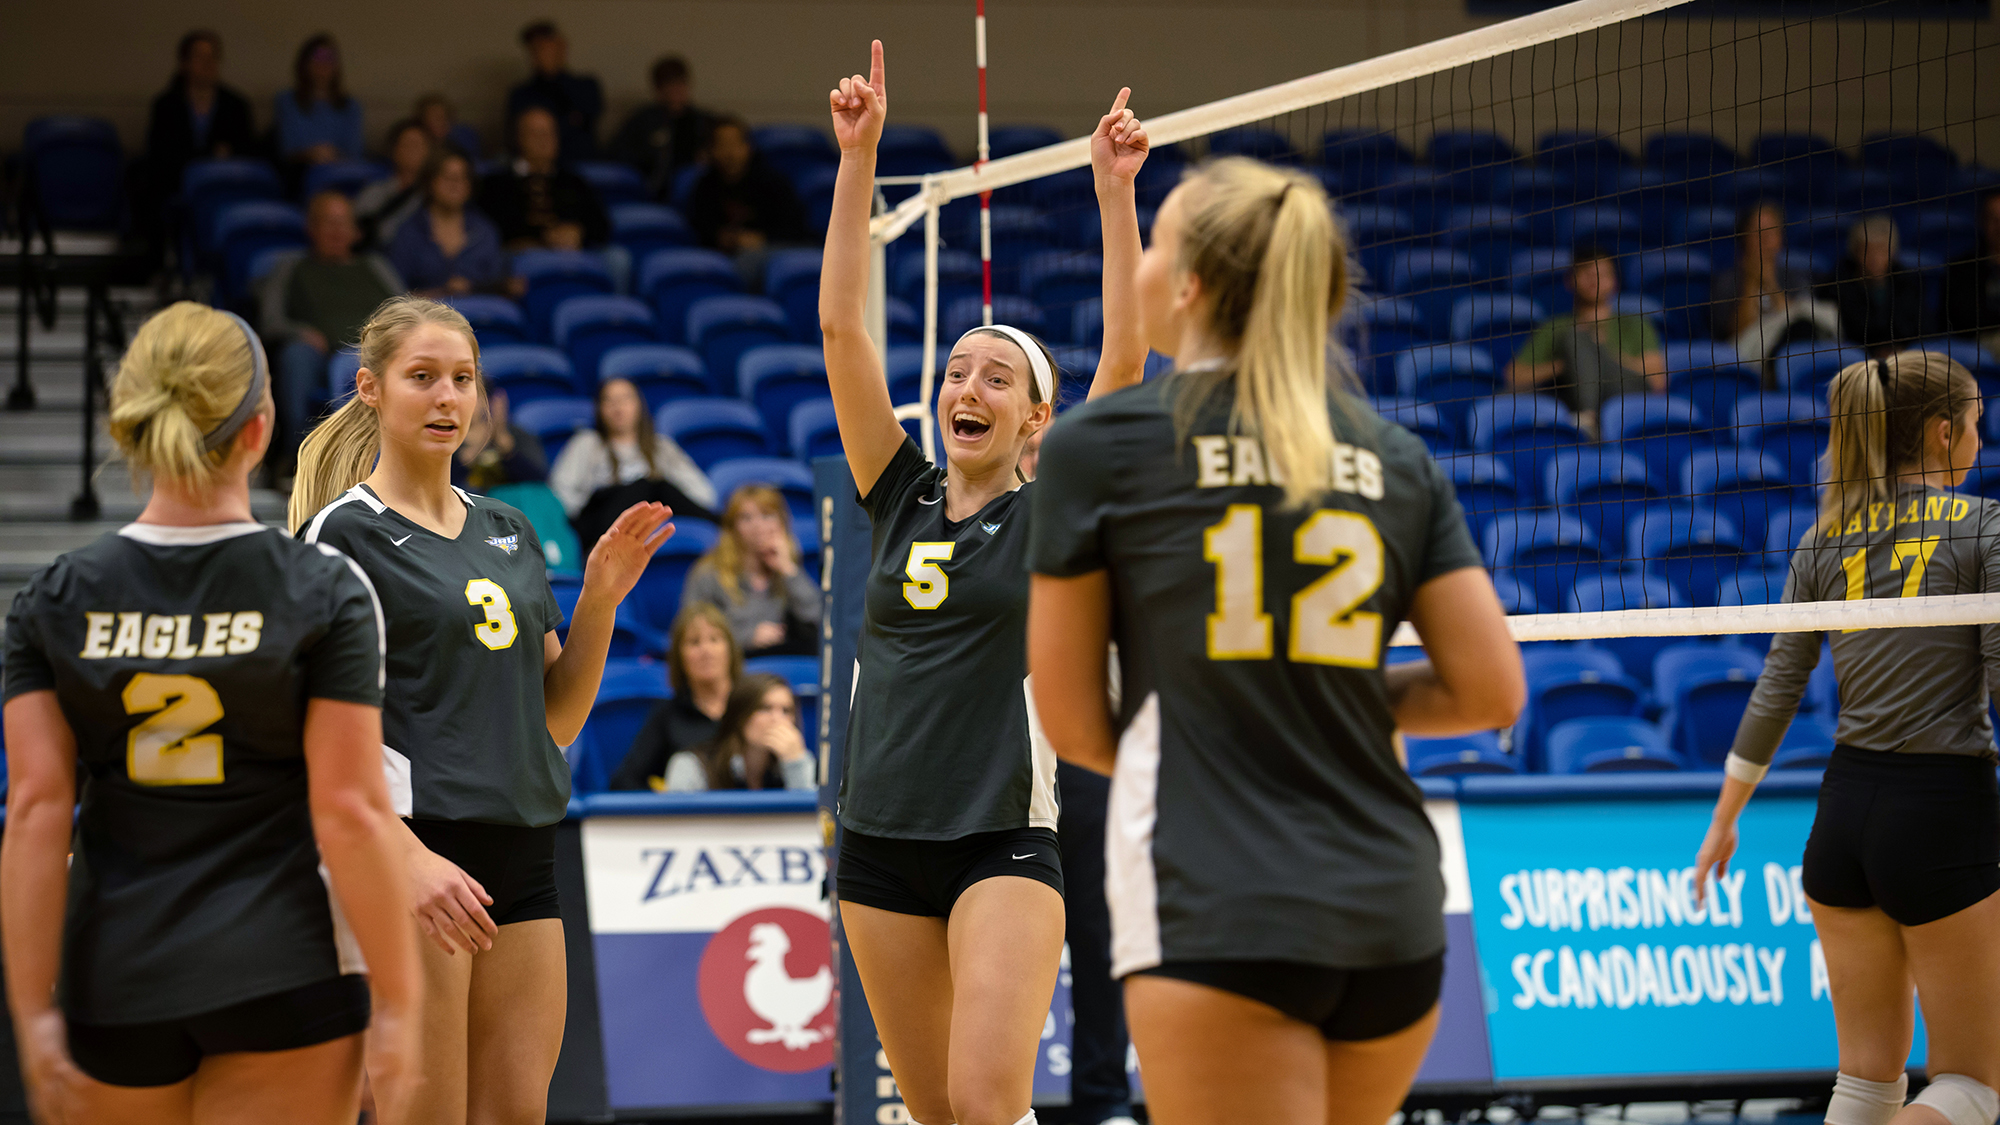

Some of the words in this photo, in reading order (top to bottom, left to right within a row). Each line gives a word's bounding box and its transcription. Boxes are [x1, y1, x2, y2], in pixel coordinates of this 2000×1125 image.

[1192, 434, 1385, 500] EAES
[902, 541, 956, 610] 5
[1203, 503, 1385, 669] 12
[1840, 535, 1941, 634] 17
[79, 610, 264, 660] EAGLES
[464, 577, 519, 651] 3
[121, 672, 225, 787] 2
[1500, 866, 1746, 931] SURPRISINGLY
[1511, 943, 1786, 1010] SCANDALOUSLY
